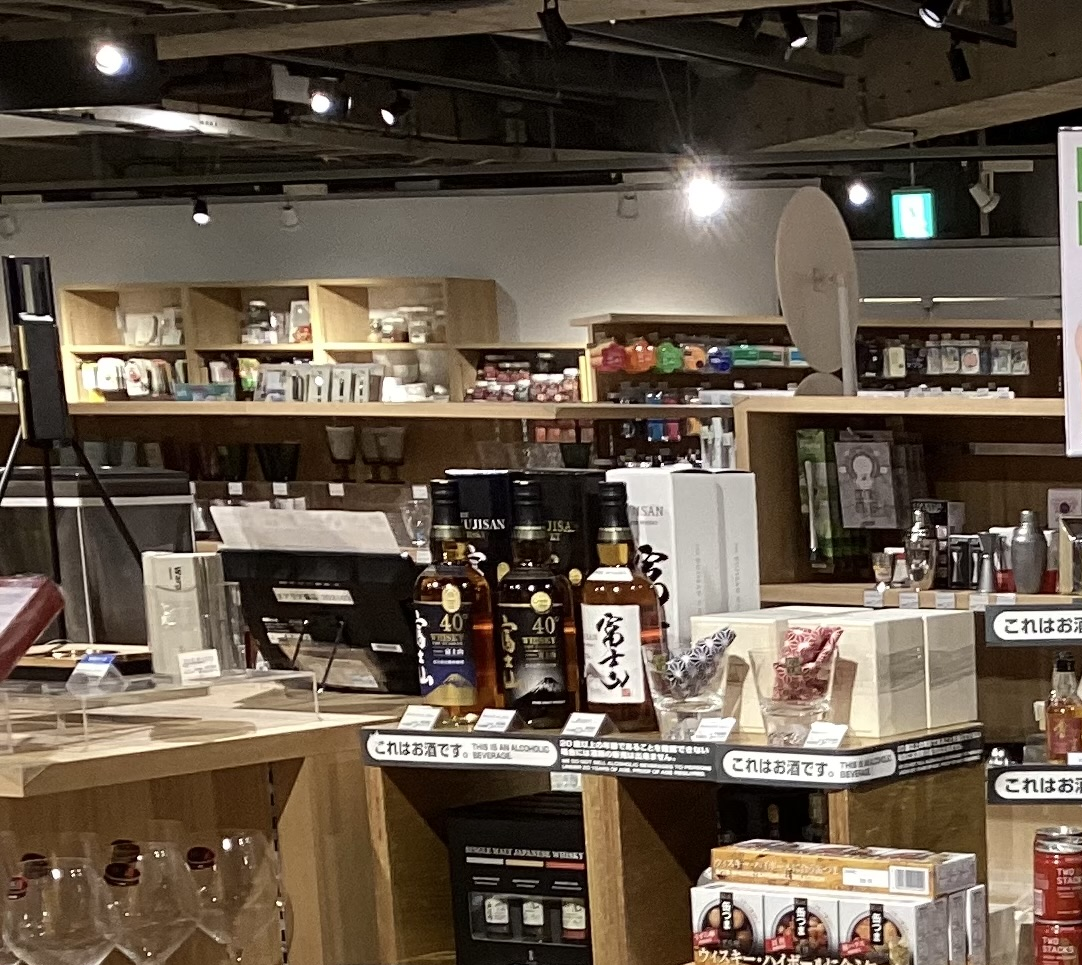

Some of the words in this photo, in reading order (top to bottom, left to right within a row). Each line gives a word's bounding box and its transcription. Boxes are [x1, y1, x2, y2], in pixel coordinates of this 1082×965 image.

[461, 519, 506, 530] UJISAN
[375, 742, 468, 759] これはお酒です。
[732, 757, 834, 778] これはお酒です。
[1056, 868, 1075, 876] TWO
[871, 912, 882, 943] 缶つま
[1042, 937, 1059, 945] TWO
[1042, 945, 1074, 953] STACKS
